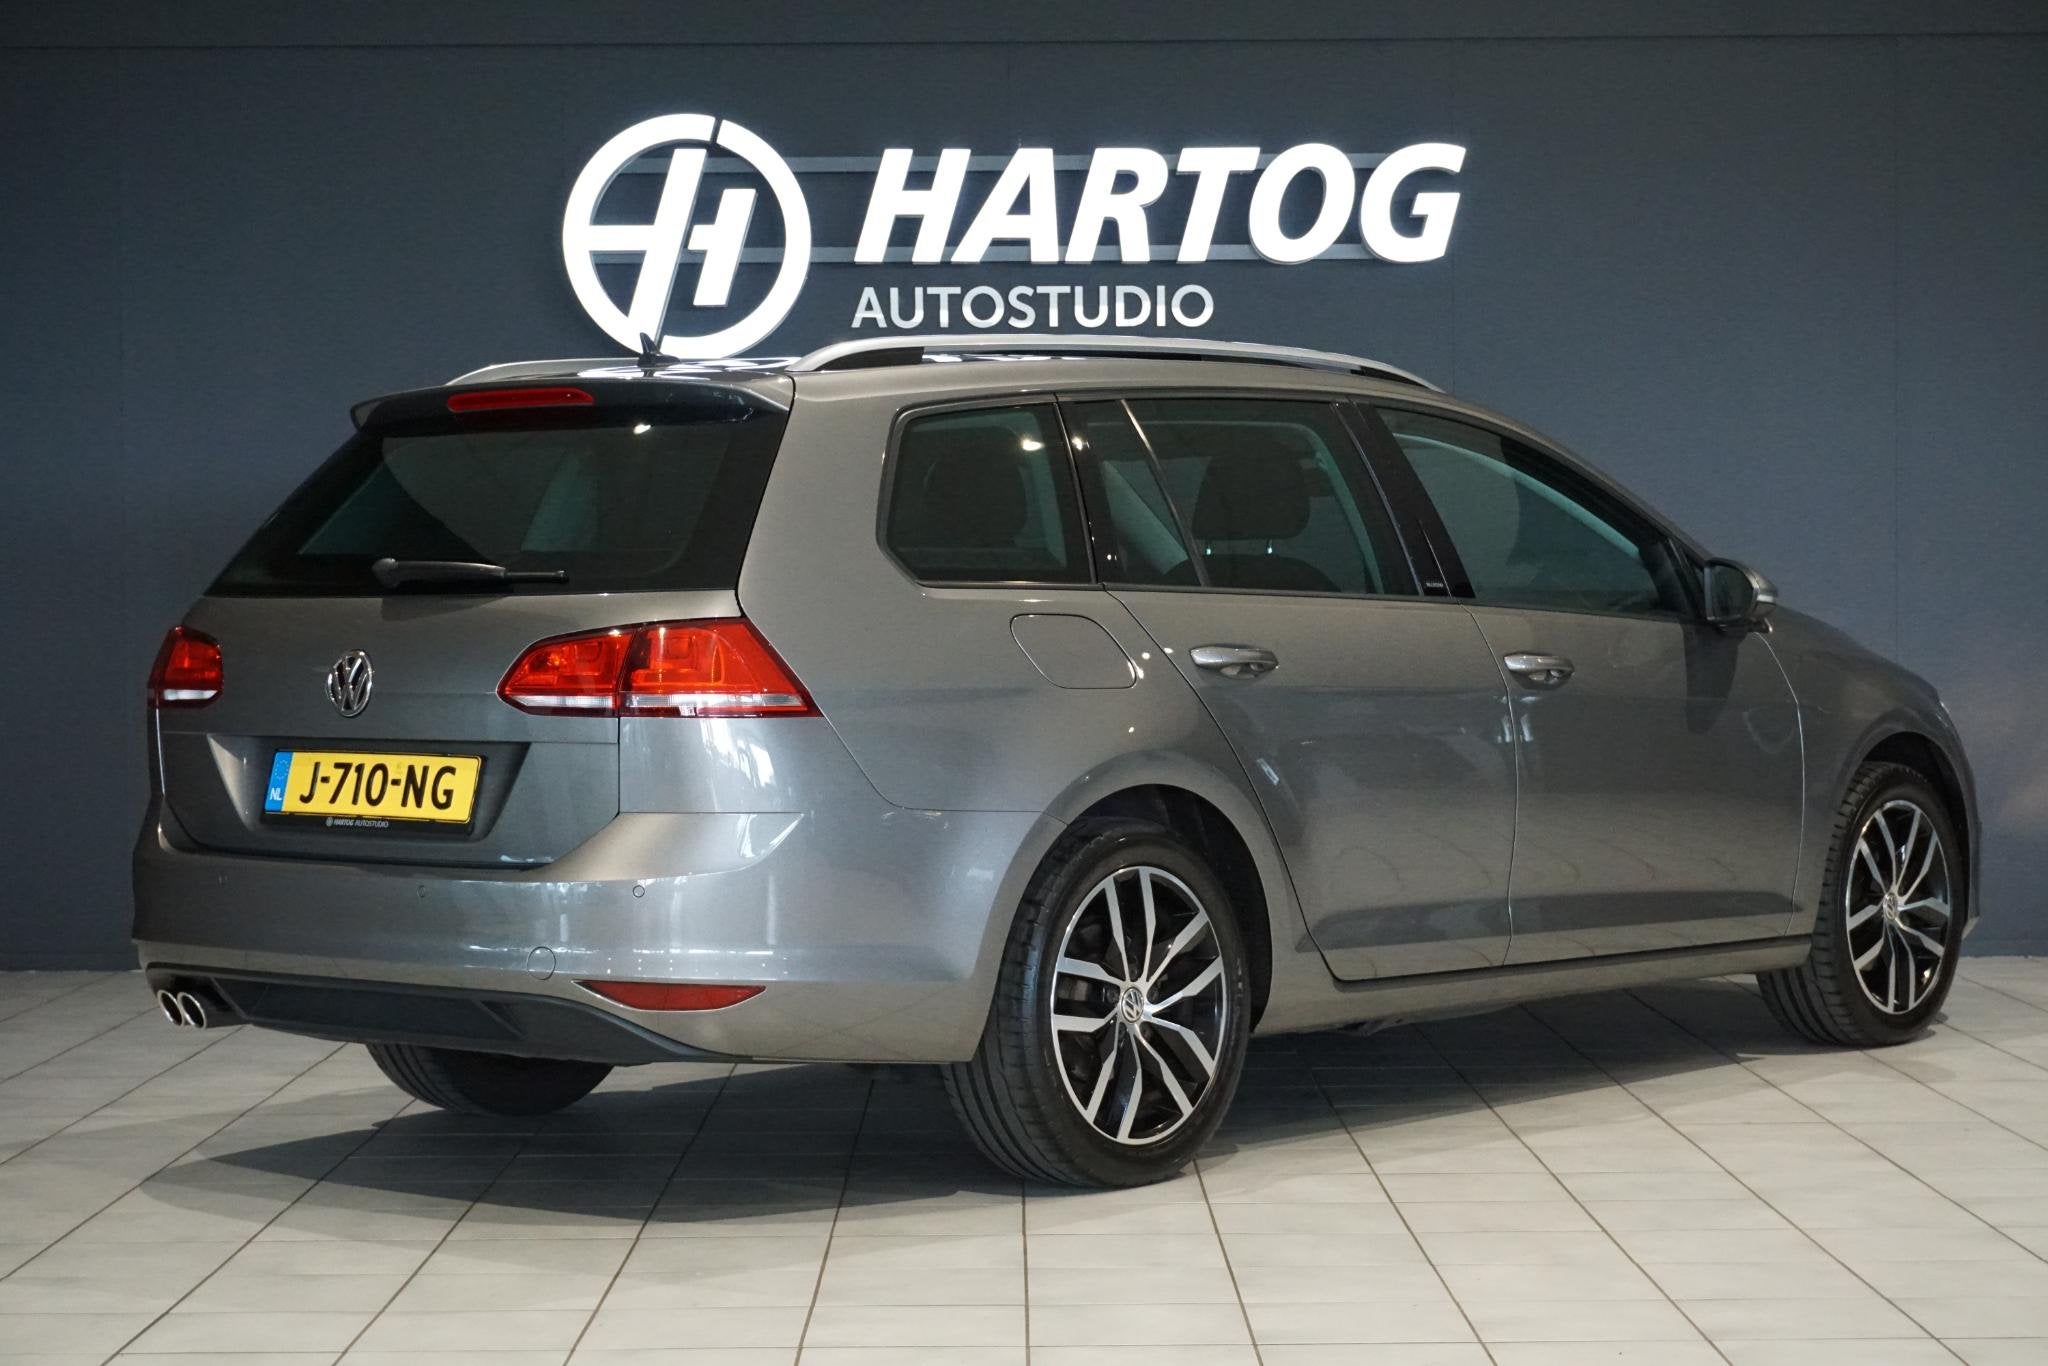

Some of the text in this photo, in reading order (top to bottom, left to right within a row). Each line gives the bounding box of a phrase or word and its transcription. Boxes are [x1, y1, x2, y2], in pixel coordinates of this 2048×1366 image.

[853, 142, 1467, 265] HARTOG
[851, 285, 1214, 329] AUTOSTUDIO
[270, 788, 283, 801] NL
[299, 761, 457, 810] J-710-NG
[354, 819, 389, 828] AUTOSTUDIO
